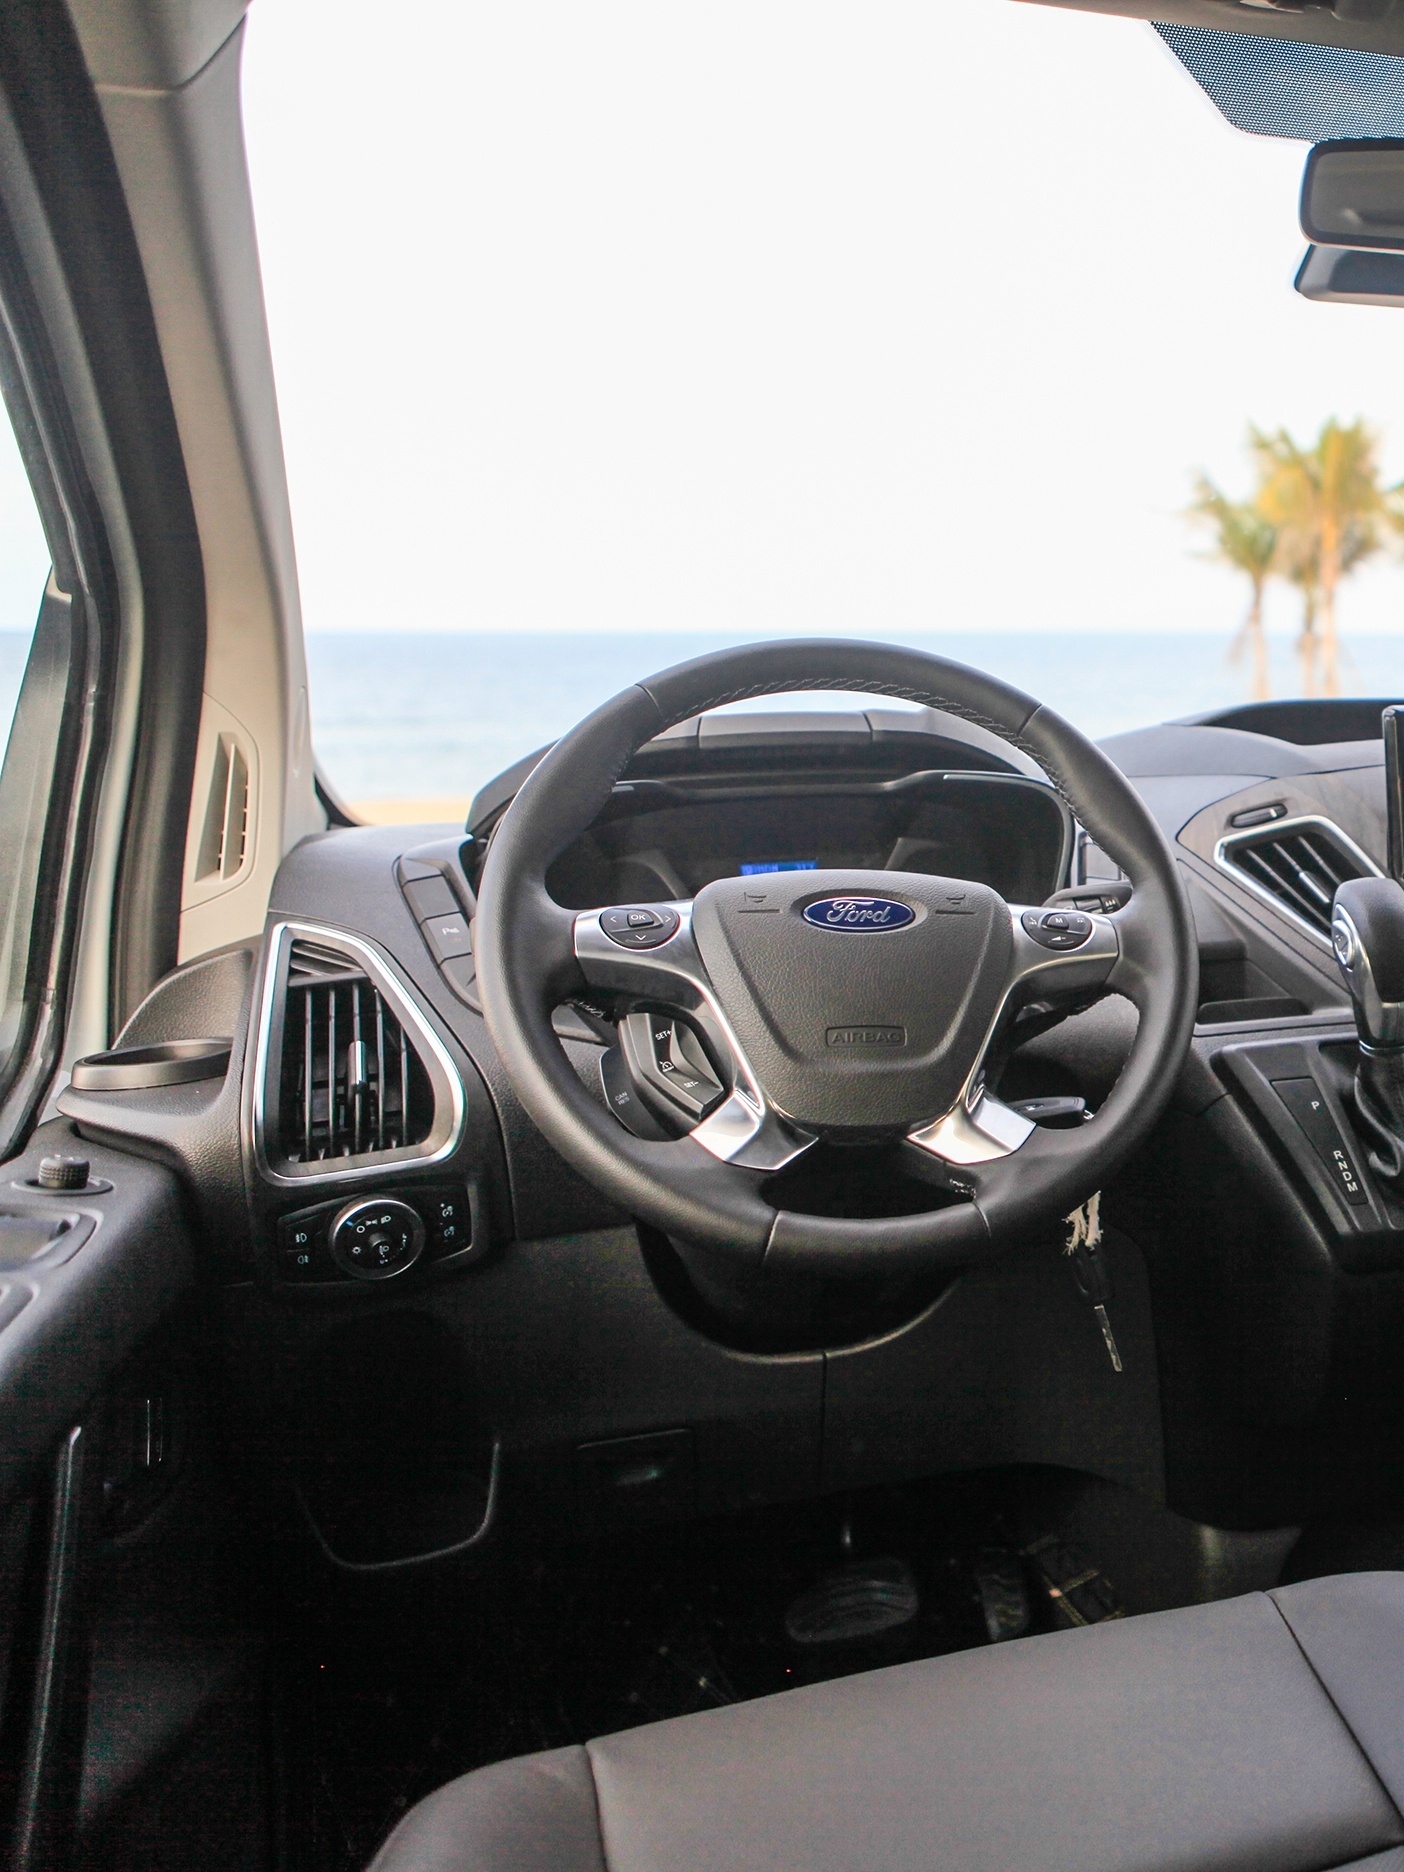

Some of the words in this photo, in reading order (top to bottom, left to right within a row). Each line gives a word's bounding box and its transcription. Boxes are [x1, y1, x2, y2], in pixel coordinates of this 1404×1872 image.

[826, 900, 891, 923] Ford
[655, 1030, 672, 1041] SET+
[831, 1031, 903, 1044] AIRBAG
[1311, 1101, 1320, 1110] P
[1333, 1150, 1344, 1160] R
[1338, 1161, 1348, 1171] N
[1342, 1171, 1352, 1181] D
[1347, 1182, 1359, 1192] M
